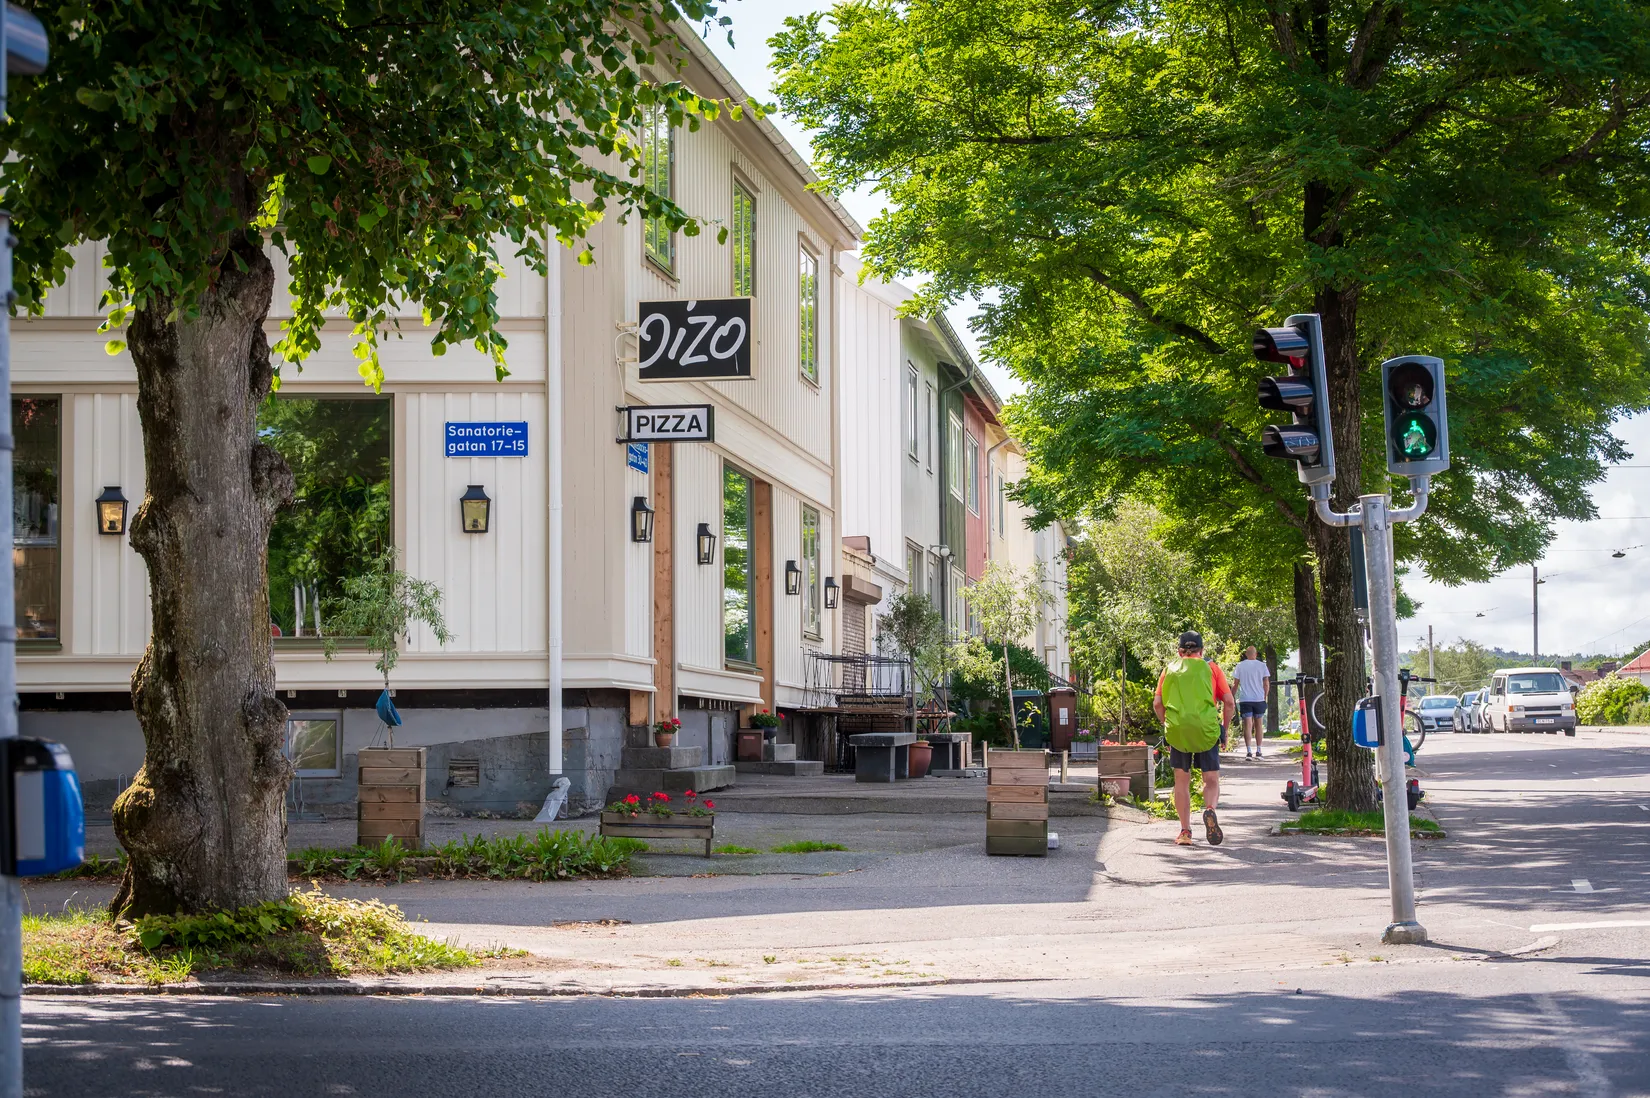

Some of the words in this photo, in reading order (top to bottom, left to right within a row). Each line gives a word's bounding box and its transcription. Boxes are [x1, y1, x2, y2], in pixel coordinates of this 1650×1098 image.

[636, 414, 703, 433] PIZZA
[448, 425, 522, 437] Sanatorie-
[448, 440, 487, 454] gatan
[491, 440, 525, 451] 17-15
